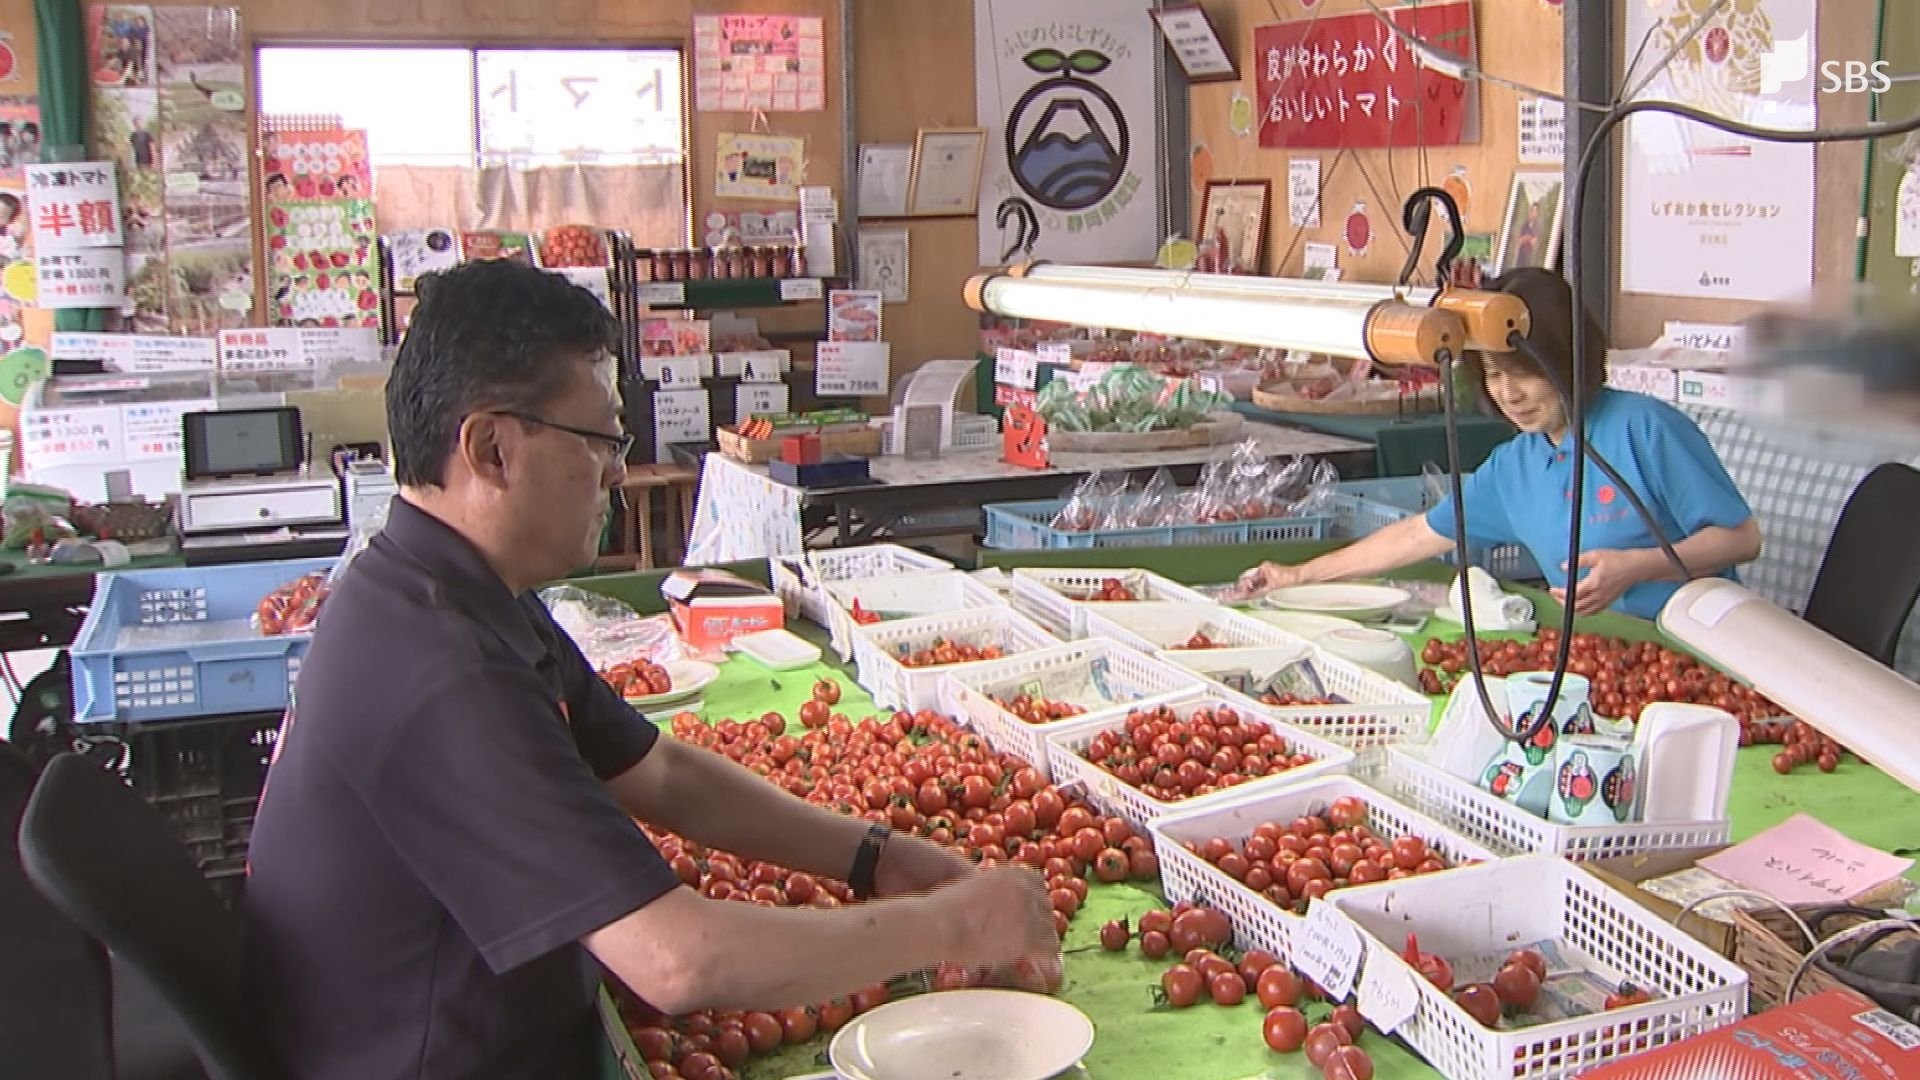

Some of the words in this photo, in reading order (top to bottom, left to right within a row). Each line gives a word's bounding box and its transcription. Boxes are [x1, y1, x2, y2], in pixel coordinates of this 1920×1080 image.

[1004, 22, 1132, 59] ふじのくにしずおか
[1269, 85, 1400, 123] おいしいトマト
[31, 168, 108, 187] 冷凍トマト
[39, 199, 116, 236] 半額
[1651, 200, 1781, 218] しずおか食セレクション
[661, 365, 672, 383] B
[743, 360, 755, 380] A
